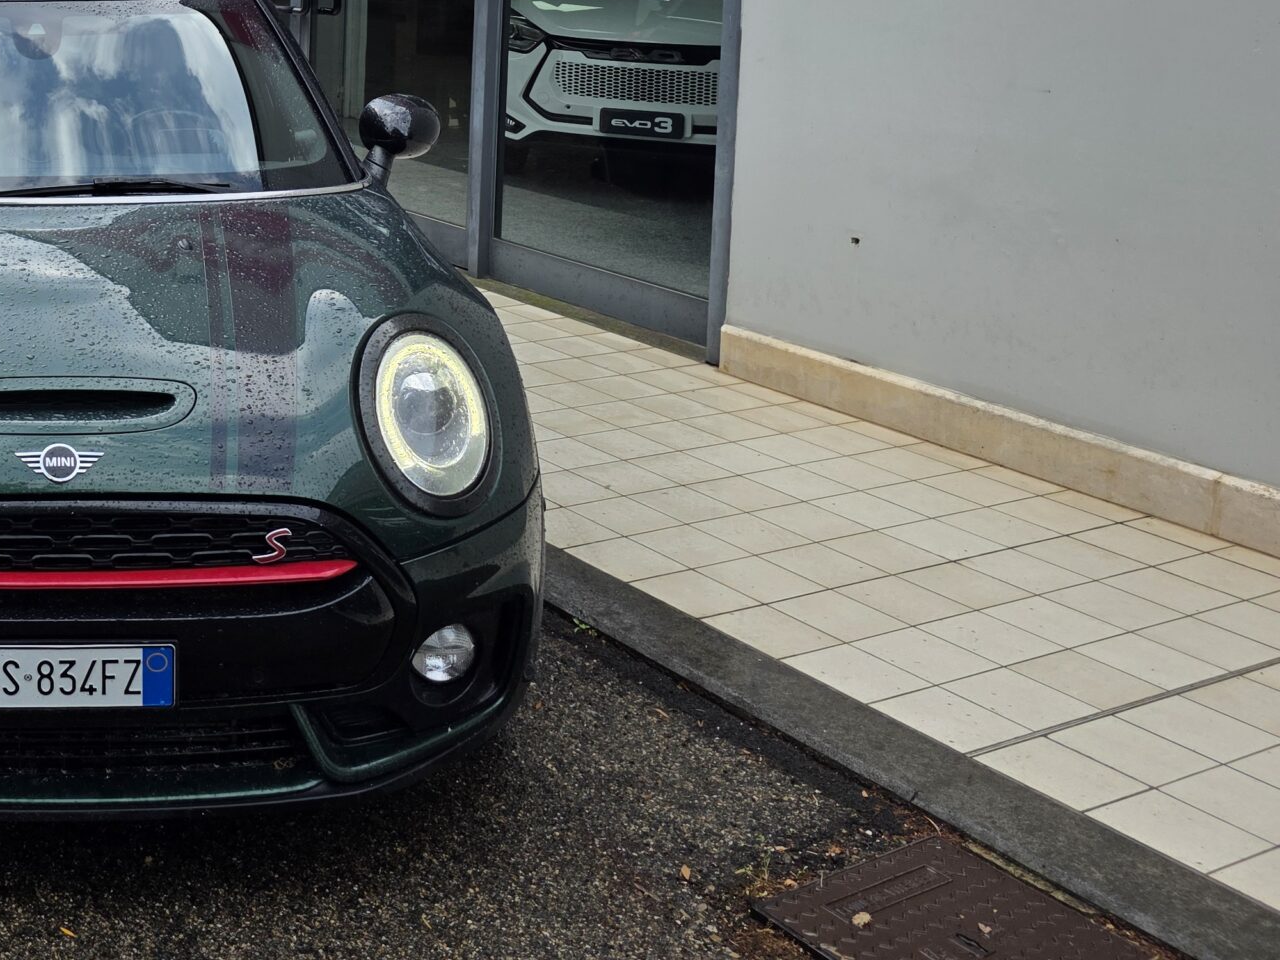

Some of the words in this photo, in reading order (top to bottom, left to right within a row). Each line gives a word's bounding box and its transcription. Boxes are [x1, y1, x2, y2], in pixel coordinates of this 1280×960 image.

[611, 118, 651, 129] EVO
[654, 117, 673, 133] 3
[45, 456, 75, 467] MINI
[252, 528, 292, 564] S
